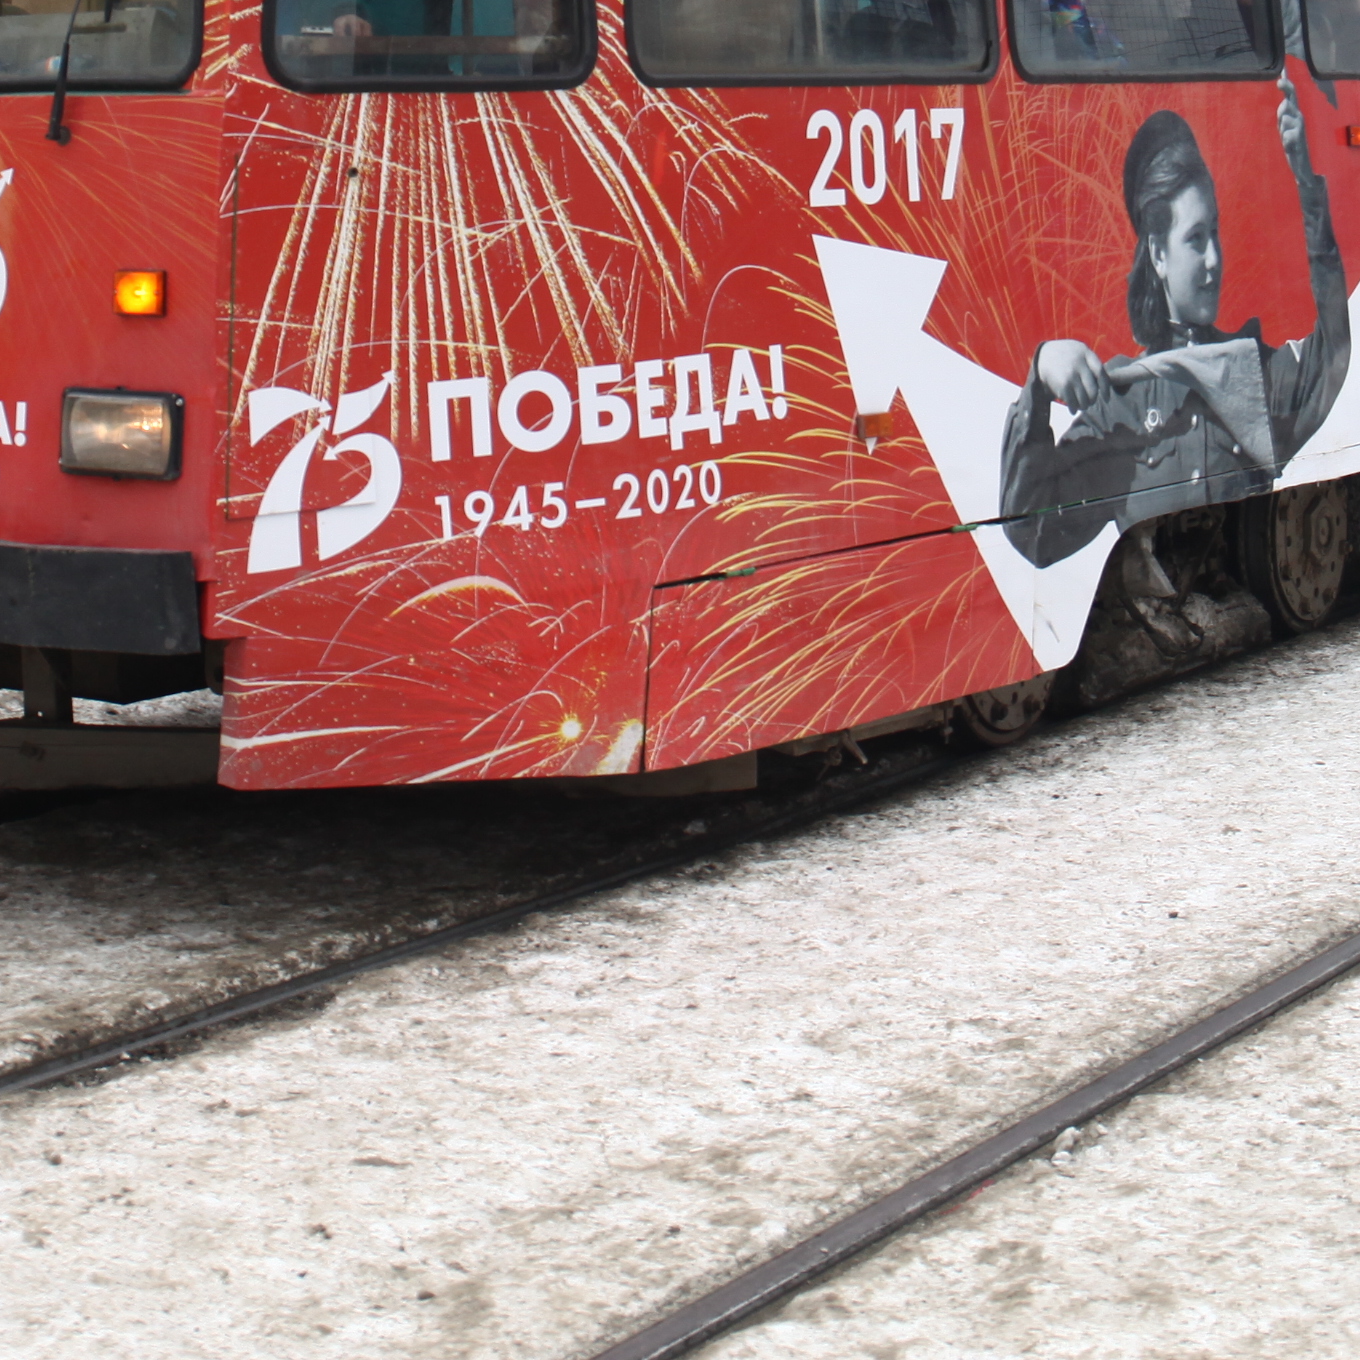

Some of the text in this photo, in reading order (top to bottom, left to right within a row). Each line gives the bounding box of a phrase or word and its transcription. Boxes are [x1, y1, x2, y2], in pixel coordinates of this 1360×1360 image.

[806, 107, 966, 207] 2017
[427, 344, 789, 462] ПОБЕДА!
[247, 370, 403, 575] 75
